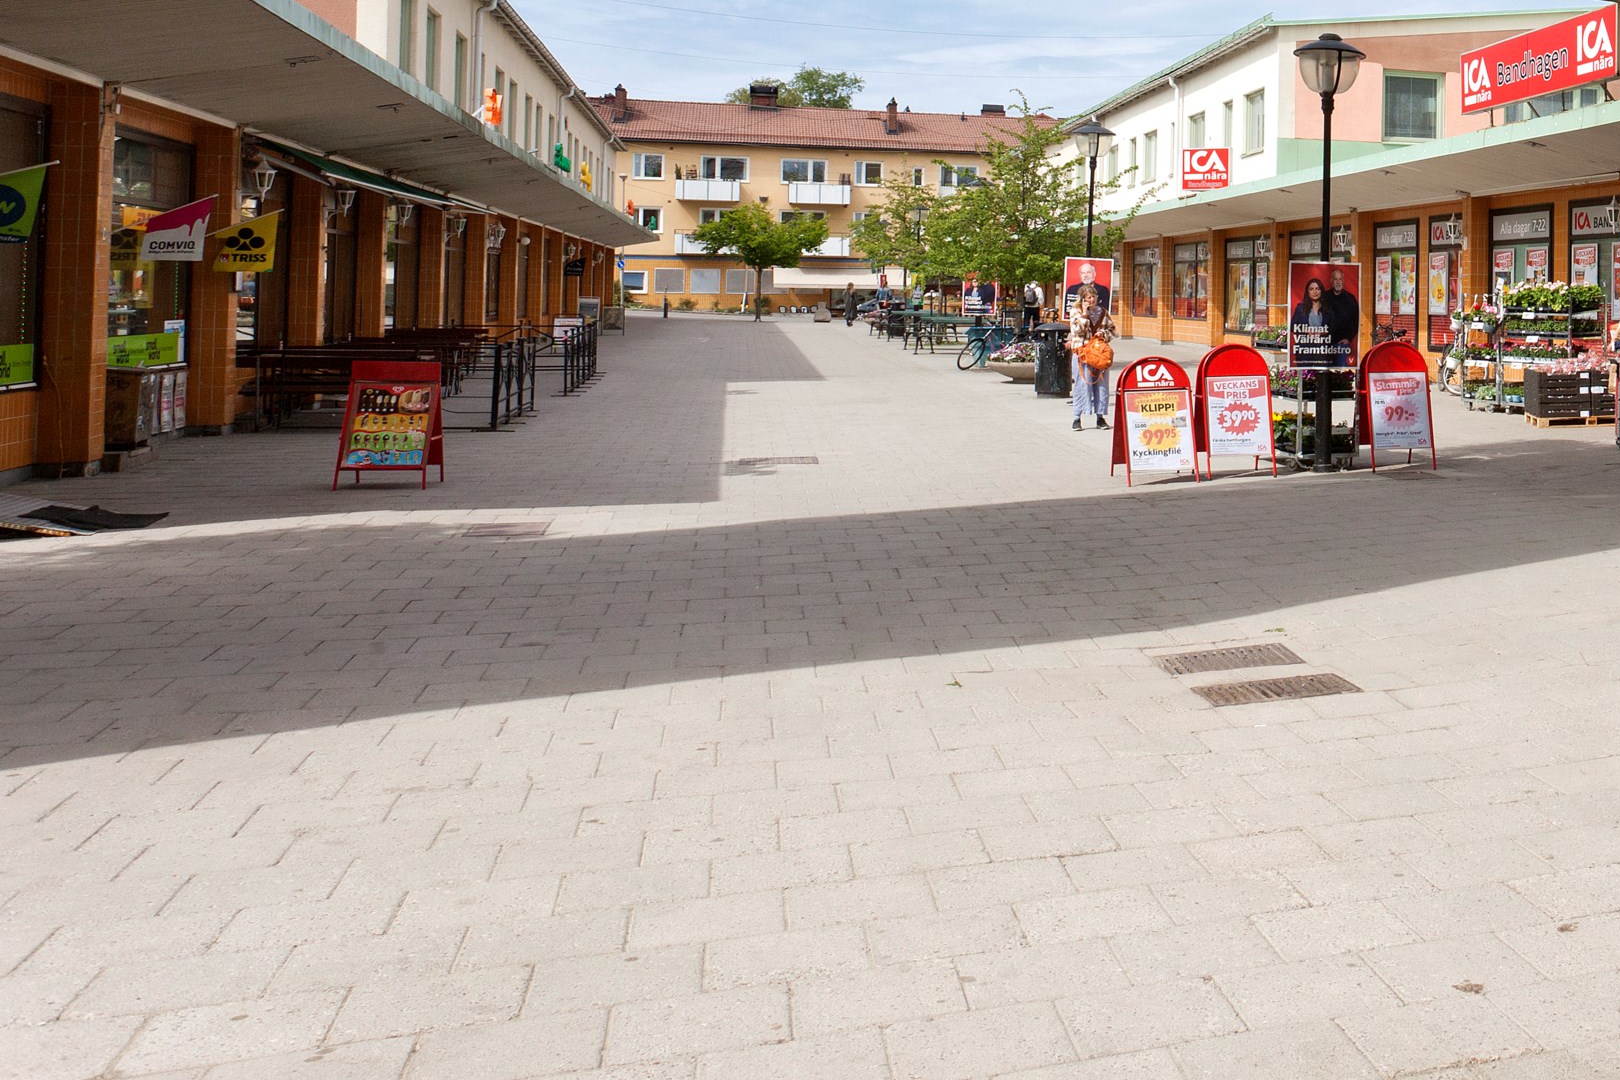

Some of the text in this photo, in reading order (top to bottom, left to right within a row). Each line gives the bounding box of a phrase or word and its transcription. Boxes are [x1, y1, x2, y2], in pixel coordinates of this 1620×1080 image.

[1576, 17, 1613, 62] ICA
[1497, 46, 1569, 87] Bandhagen
[1593, 54, 1614, 71] nära
[1464, 57, 1491, 94] ICA
[1476, 89, 1492, 103] nära
[1183, 150, 1226, 173] ICA
[1204, 171, 1227, 180] nära
[1574, 212, 1591, 229] ICA
[1433, 226, 1444, 240] ICA
[1500, 219, 1546, 237] Alla dagar 7-22
[149, 240, 196, 250] COMVIQ
[231, 253, 267, 263] TRISS
[1293, 323, 1328, 333] Klimat
[1293, 334, 1331, 344] Välfärd
[1293, 345, 1351, 354] Framtidstro
[1136, 364, 1173, 381] ICA
[1215, 381, 1257, 390] VECKANS
[1376, 380, 1417, 390] Stammis
[1226, 391, 1247, 399] PRIS
[1141, 403, 1174, 412] KLIPP!
[1133, 447, 1181, 458] Kycklingfilé
